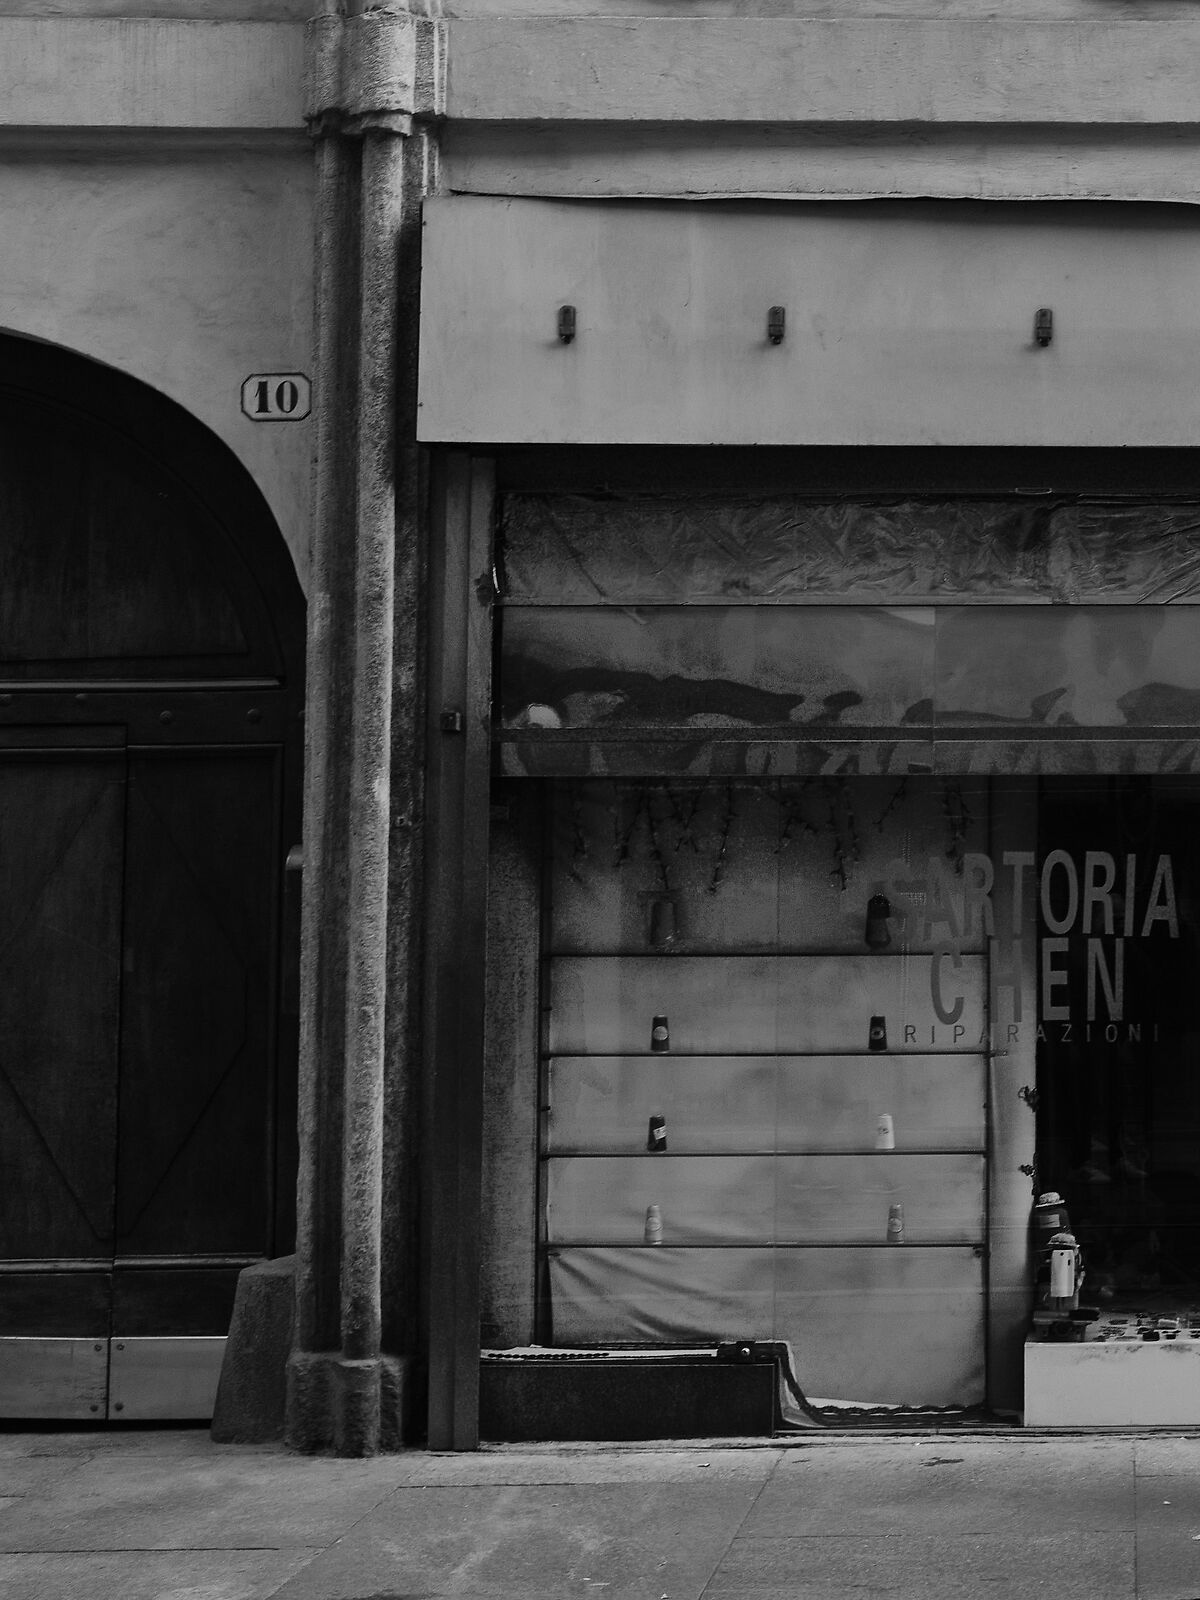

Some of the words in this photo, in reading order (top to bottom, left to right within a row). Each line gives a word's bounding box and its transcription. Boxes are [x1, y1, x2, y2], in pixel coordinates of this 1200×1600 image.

[254, 380, 299, 414] 10
[887, 848, 1180, 939] SARTORIA
[930, 936, 1125, 1026] CHEN
[903, 1023, 1160, 1044] RIPARAZIONI
